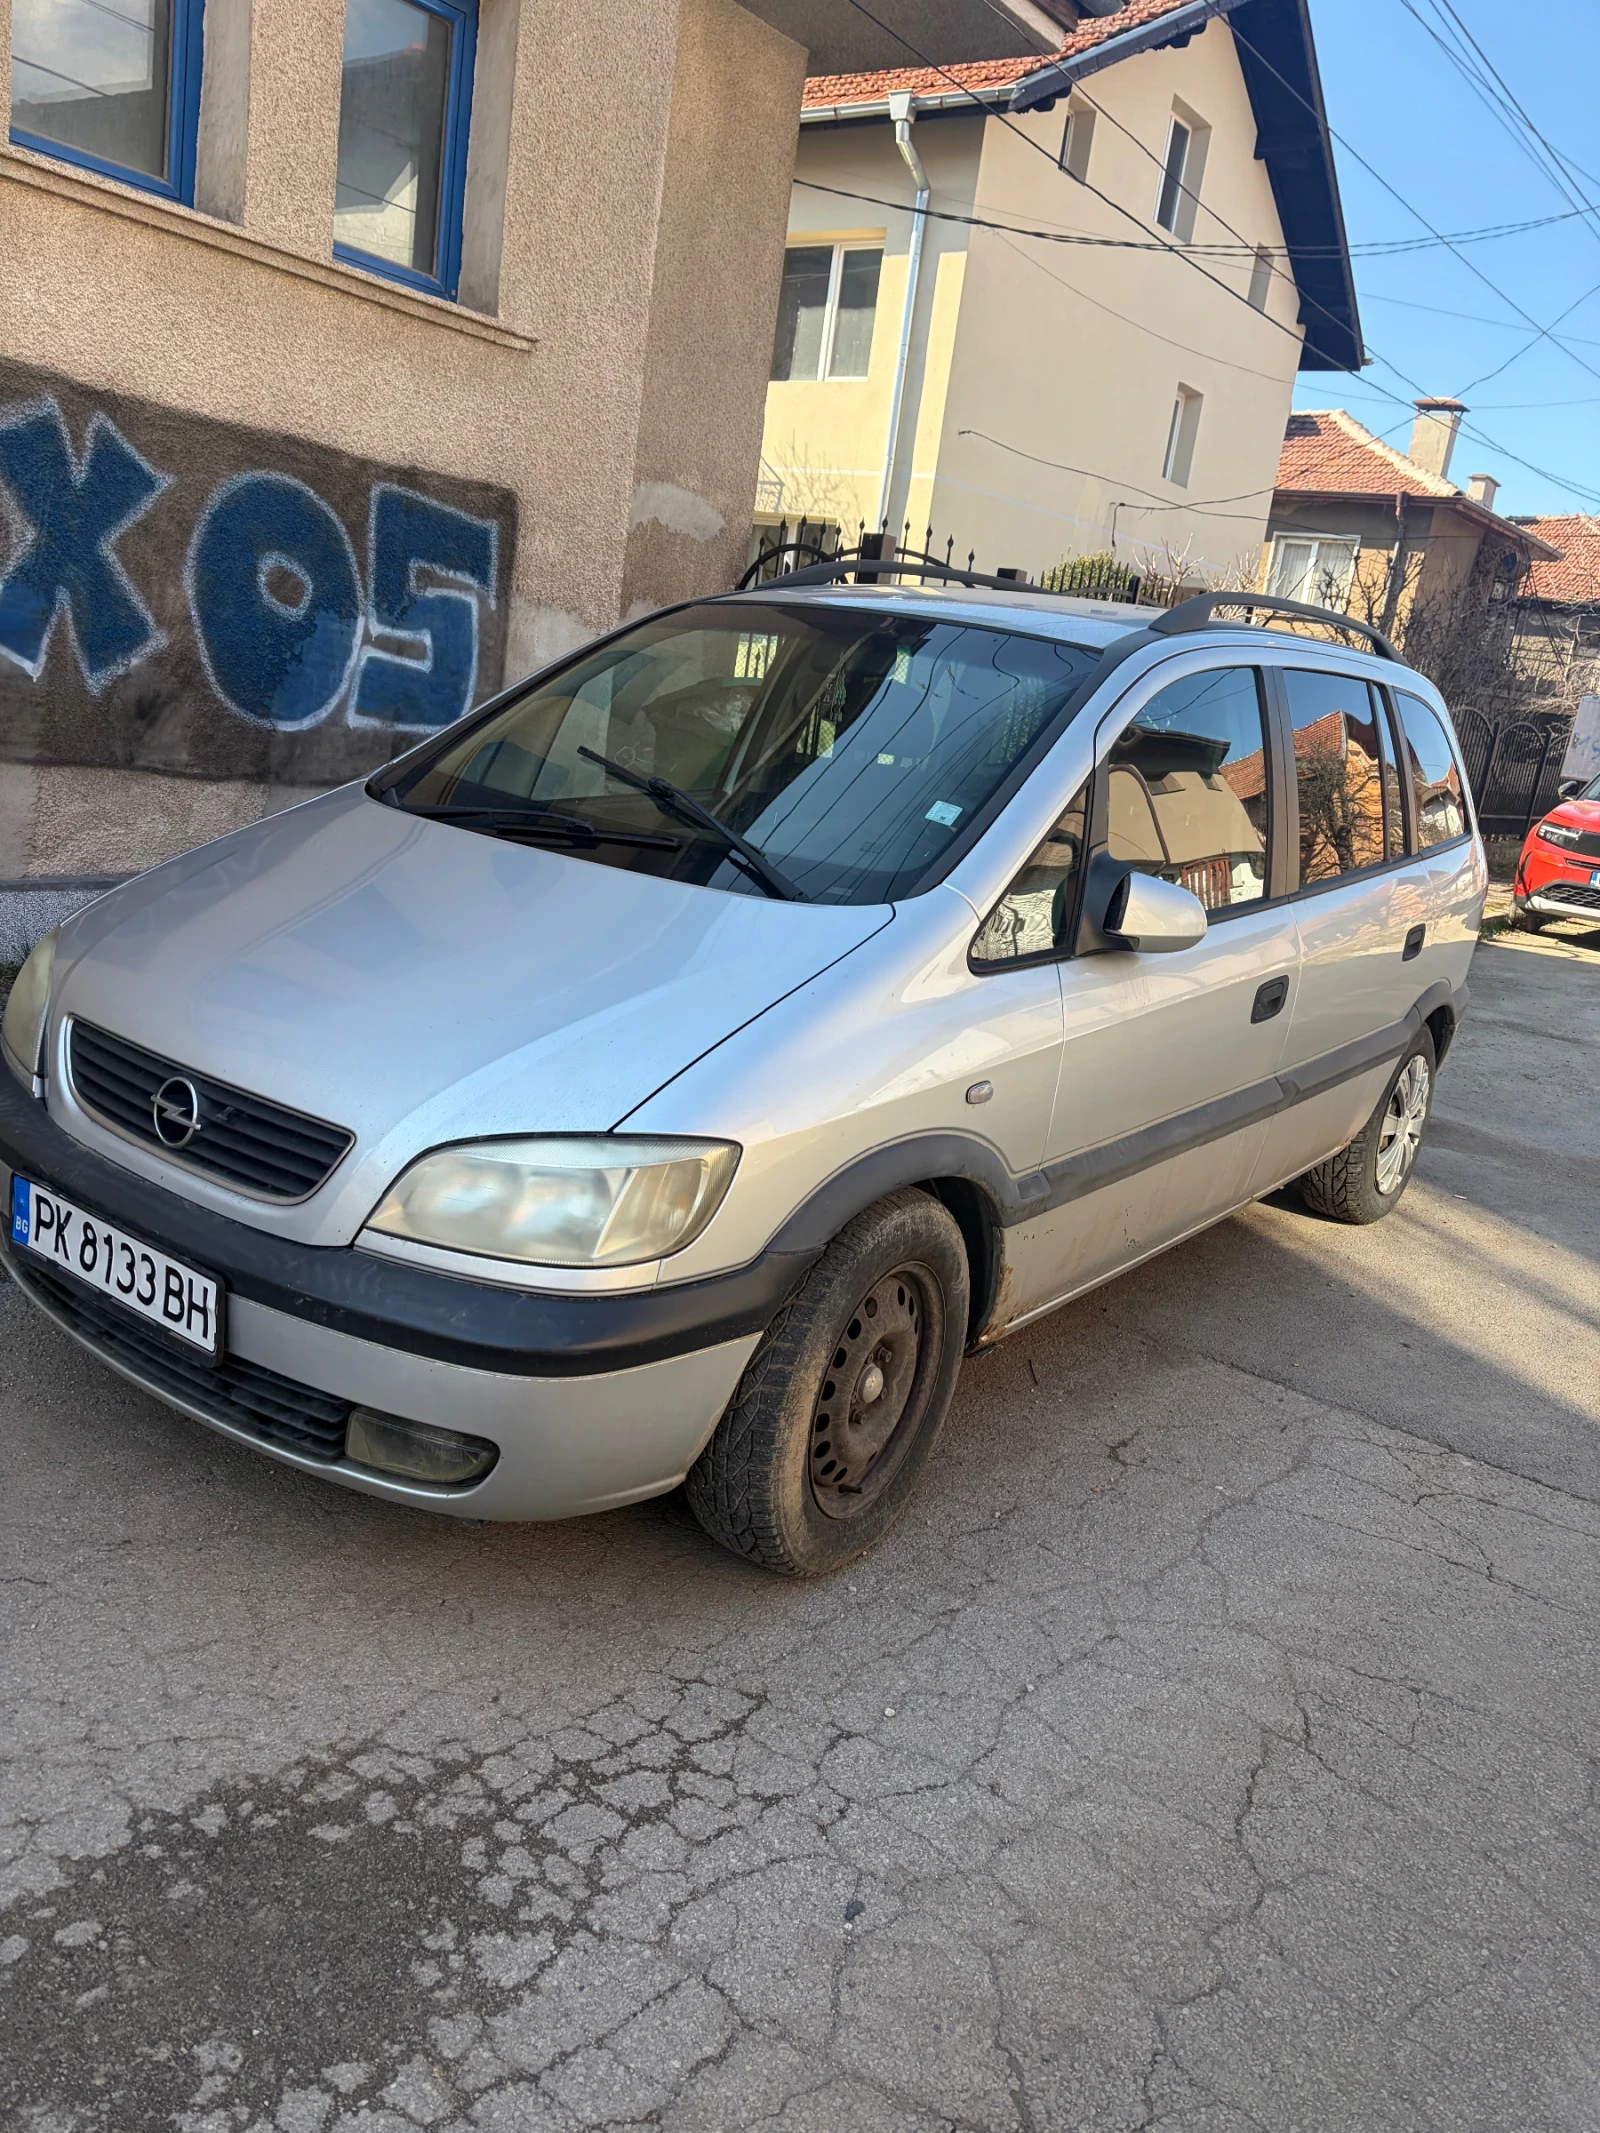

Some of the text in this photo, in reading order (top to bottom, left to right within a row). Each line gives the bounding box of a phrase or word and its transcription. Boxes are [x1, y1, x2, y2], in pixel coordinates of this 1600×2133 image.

[15, 1215, 29, 1234] BG
[34, 1193, 210, 1340] PK 8133 BH
